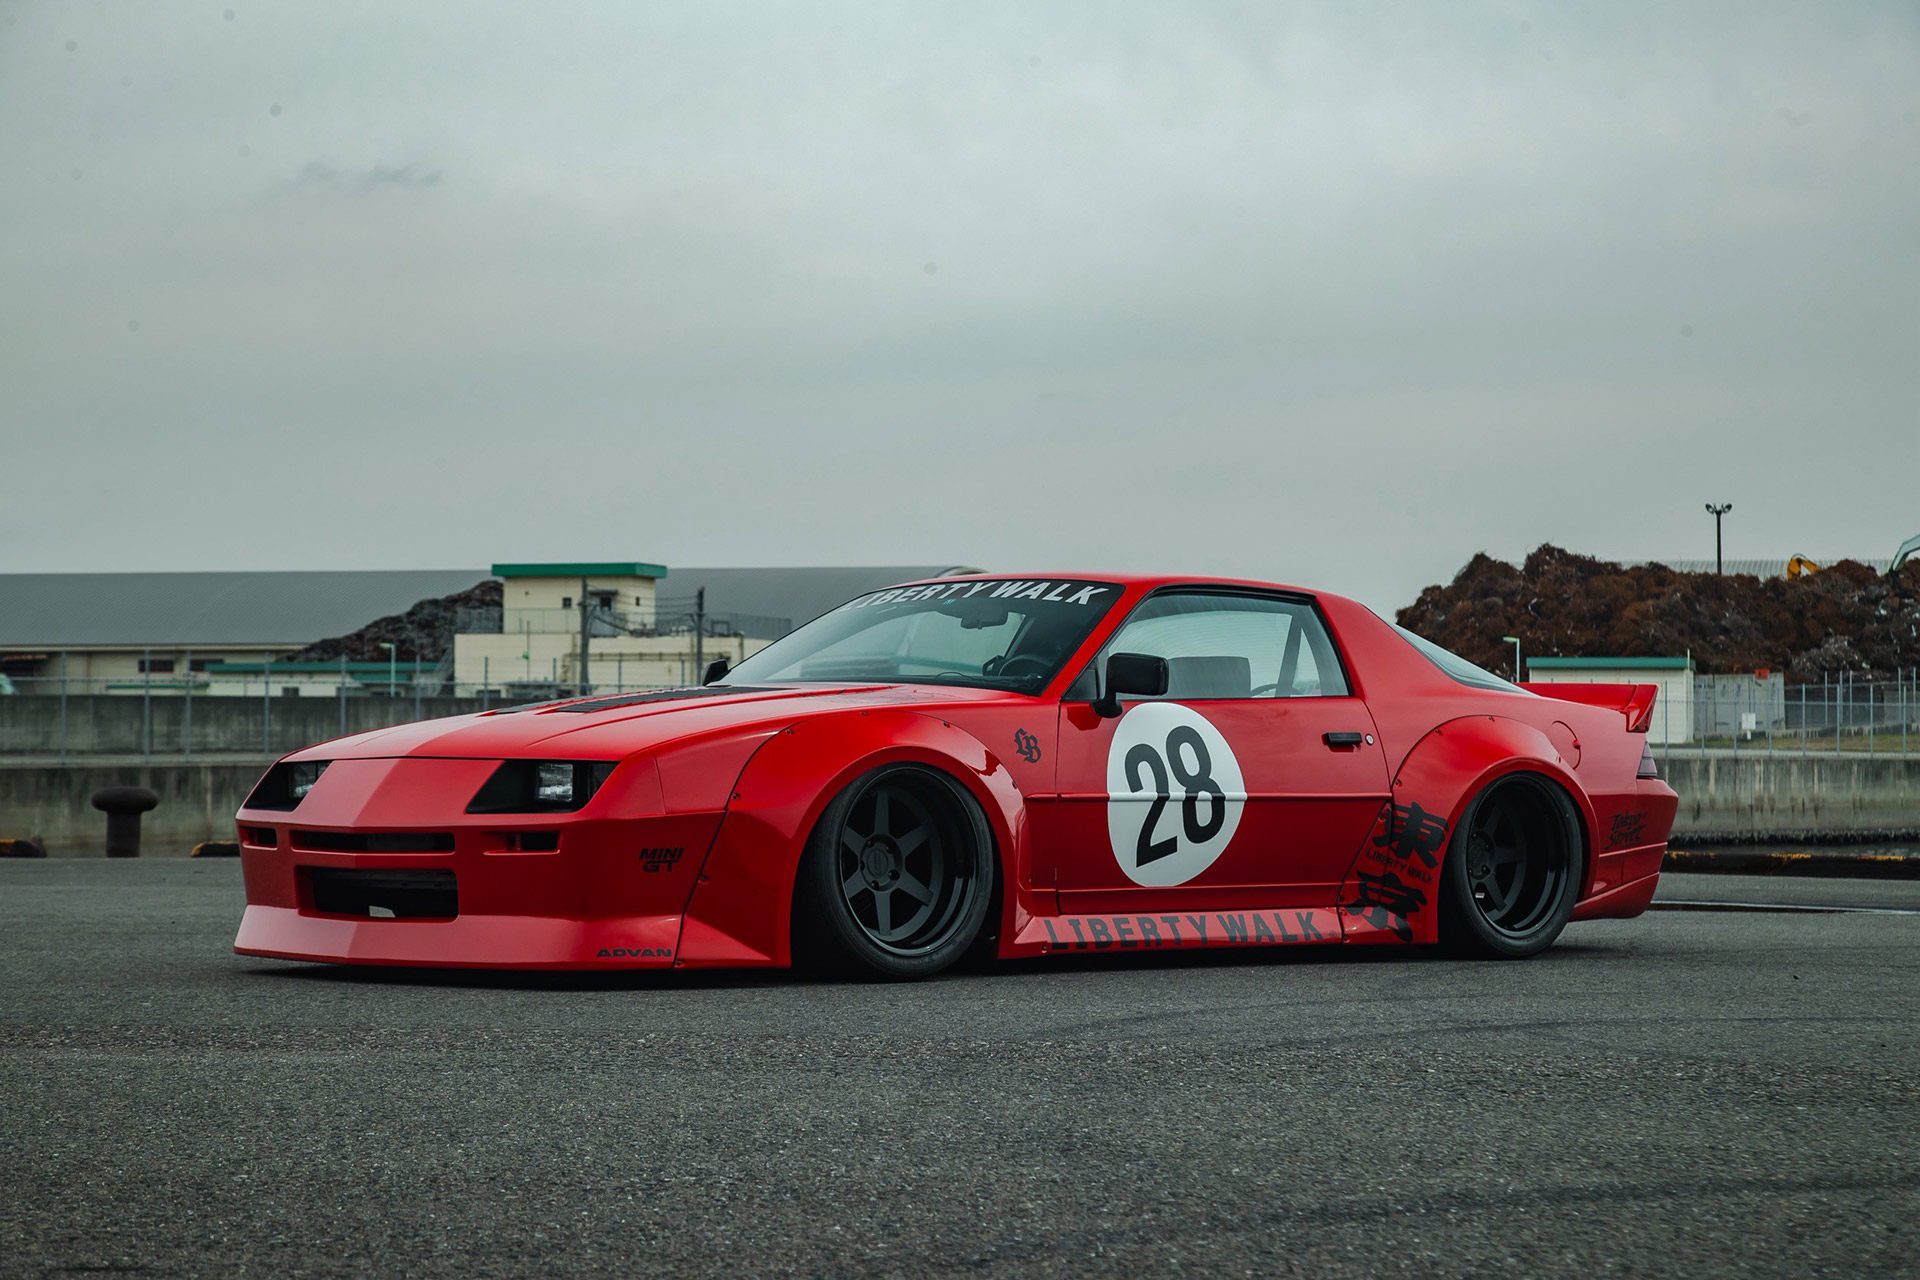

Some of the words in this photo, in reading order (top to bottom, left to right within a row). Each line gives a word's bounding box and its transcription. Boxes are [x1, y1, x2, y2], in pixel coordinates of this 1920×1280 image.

[838, 582, 997, 613] LIBERTY
[989, 581, 1109, 605] WALK
[1124, 725, 1226, 868] 28
[1371, 801, 1449, 869] 東
[639, 847, 684, 860] MINI
[642, 860, 680, 872] GT
[1366, 848, 1406, 873] LIBERTY
[1407, 865, 1434, 884] WALK
[1344, 870, 1428, 943] 京
[1043, 914, 1208, 950] LIBERTY
[1216, 910, 1324, 944] WALK
[596, 948, 672, 958] ADVAN
